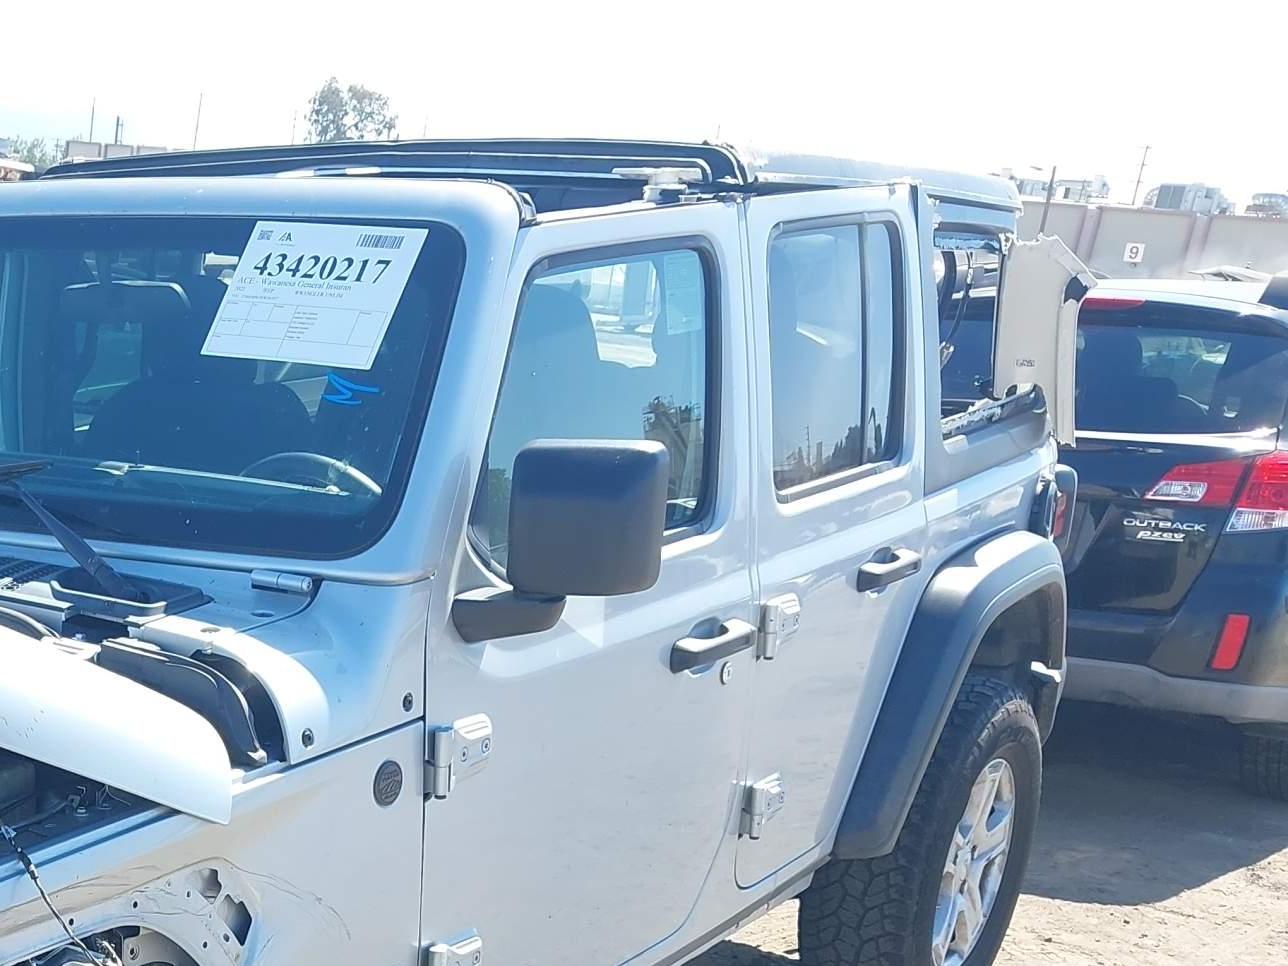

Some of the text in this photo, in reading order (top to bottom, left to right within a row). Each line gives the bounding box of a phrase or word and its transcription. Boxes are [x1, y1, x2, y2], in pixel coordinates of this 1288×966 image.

[1128, 245, 1140, 260] 9
[253, 251, 393, 285] 43420217
[297, 280, 326, 290] General
[326, 281, 352, 292] Insuran
[1122, 518, 1208, 532] OUTBACK
